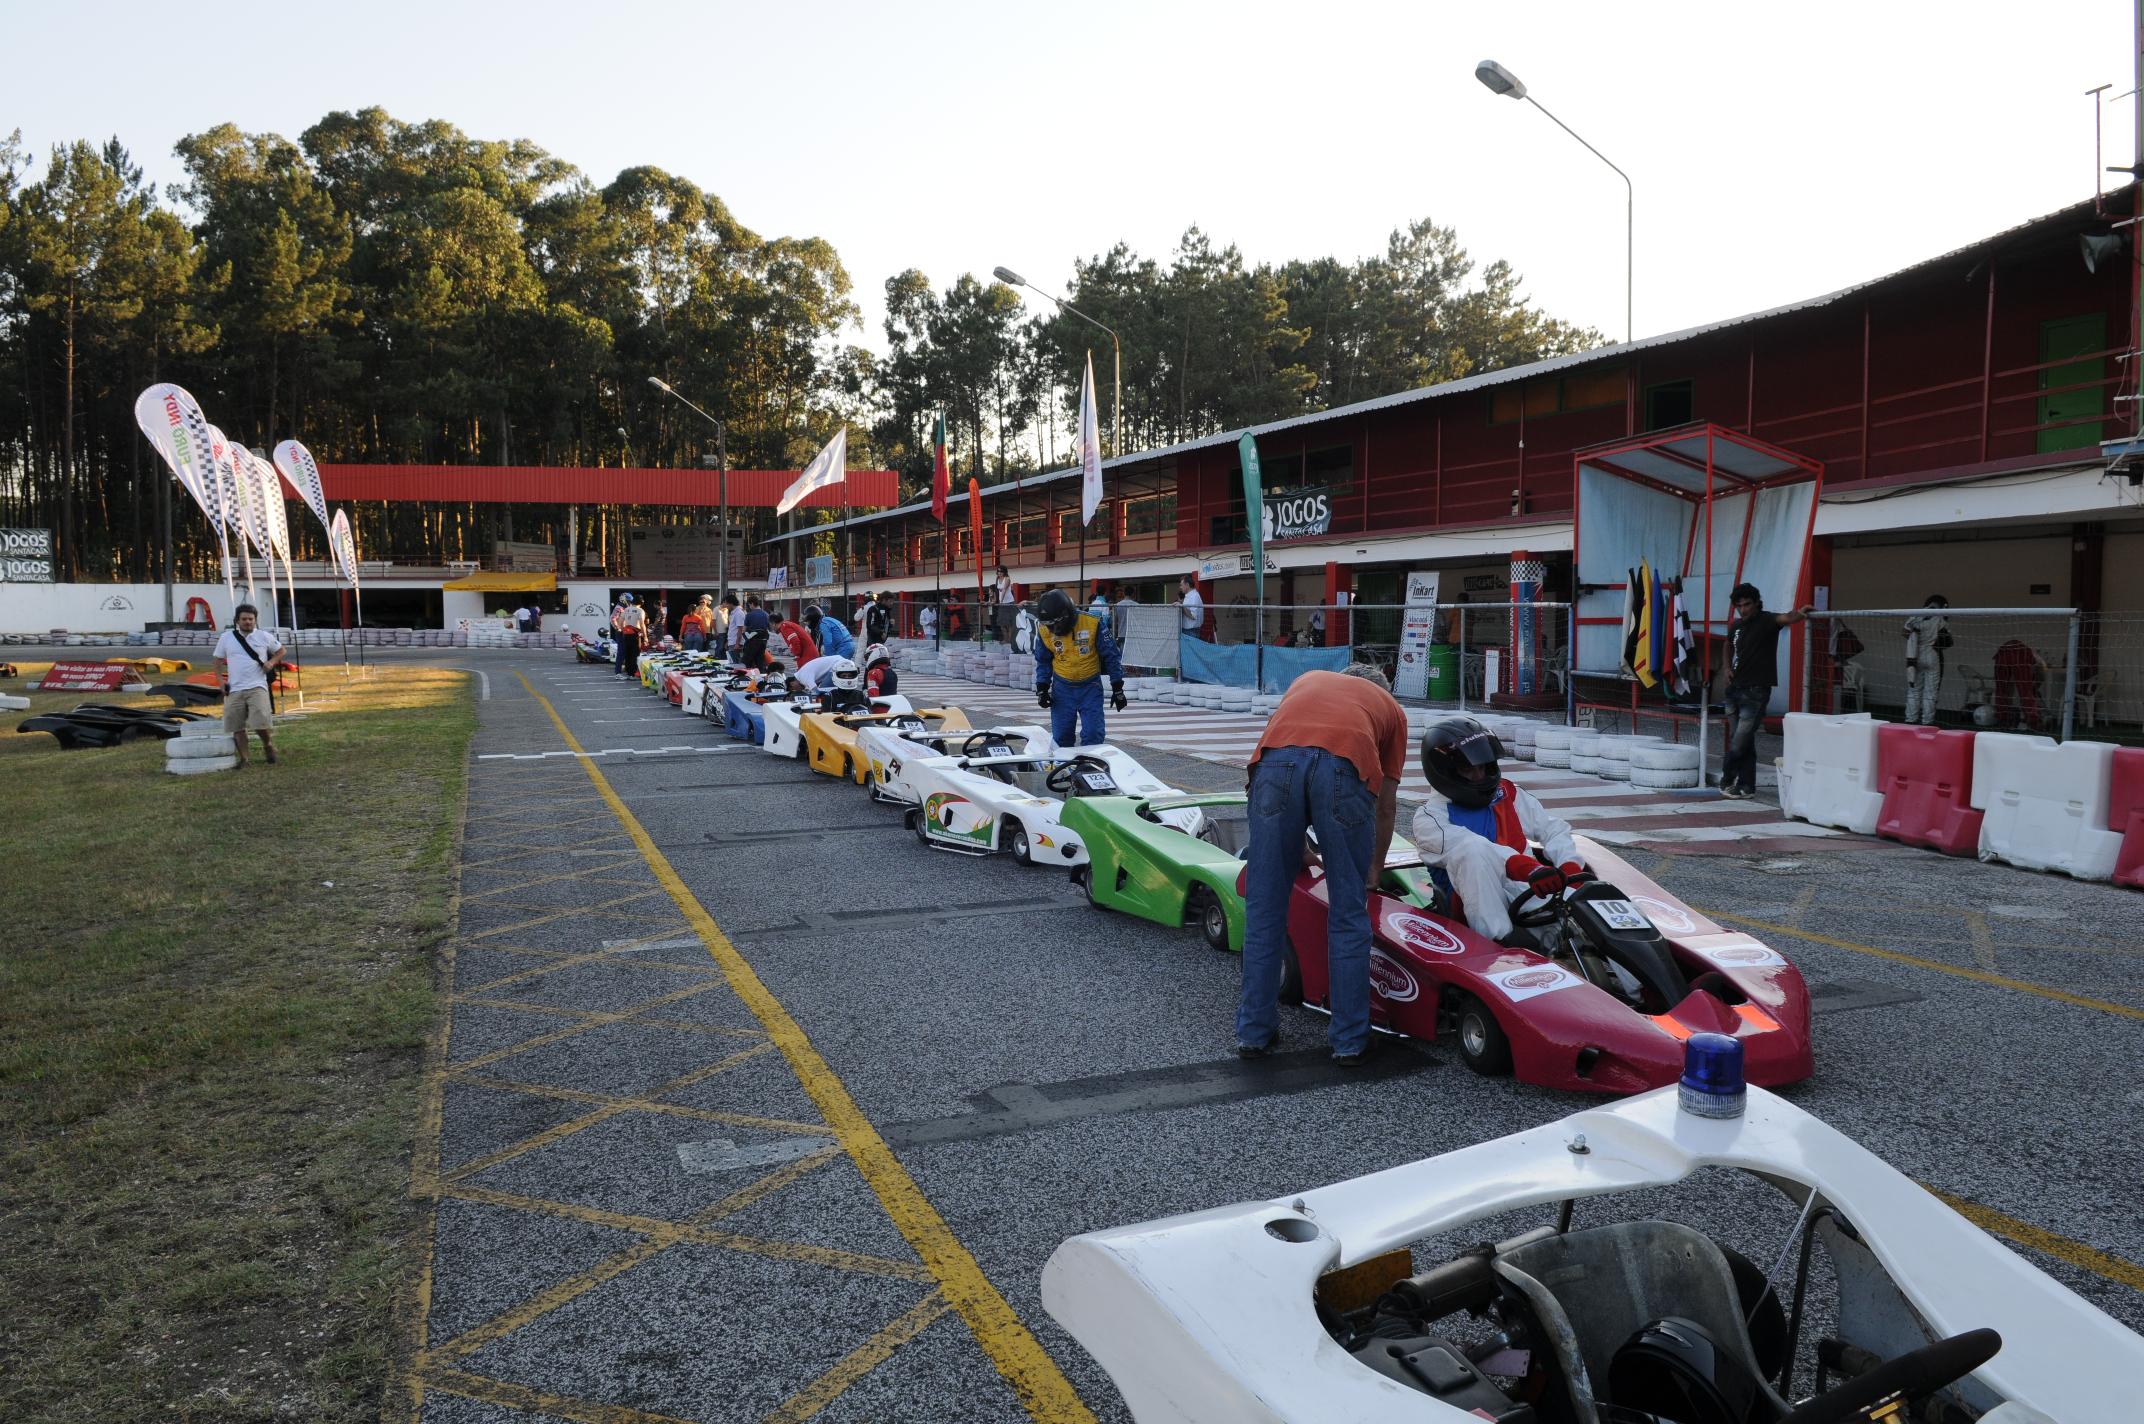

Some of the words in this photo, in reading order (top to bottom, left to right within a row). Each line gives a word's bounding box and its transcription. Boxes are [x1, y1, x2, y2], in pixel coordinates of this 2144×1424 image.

[1276, 494, 1327, 535] JOGOS
[5, 534, 48, 551] JOGOS
[7, 561, 50, 577] JOGOS
[1597, 901, 1629, 914] 10
[1370, 959, 1407, 987] illennium
